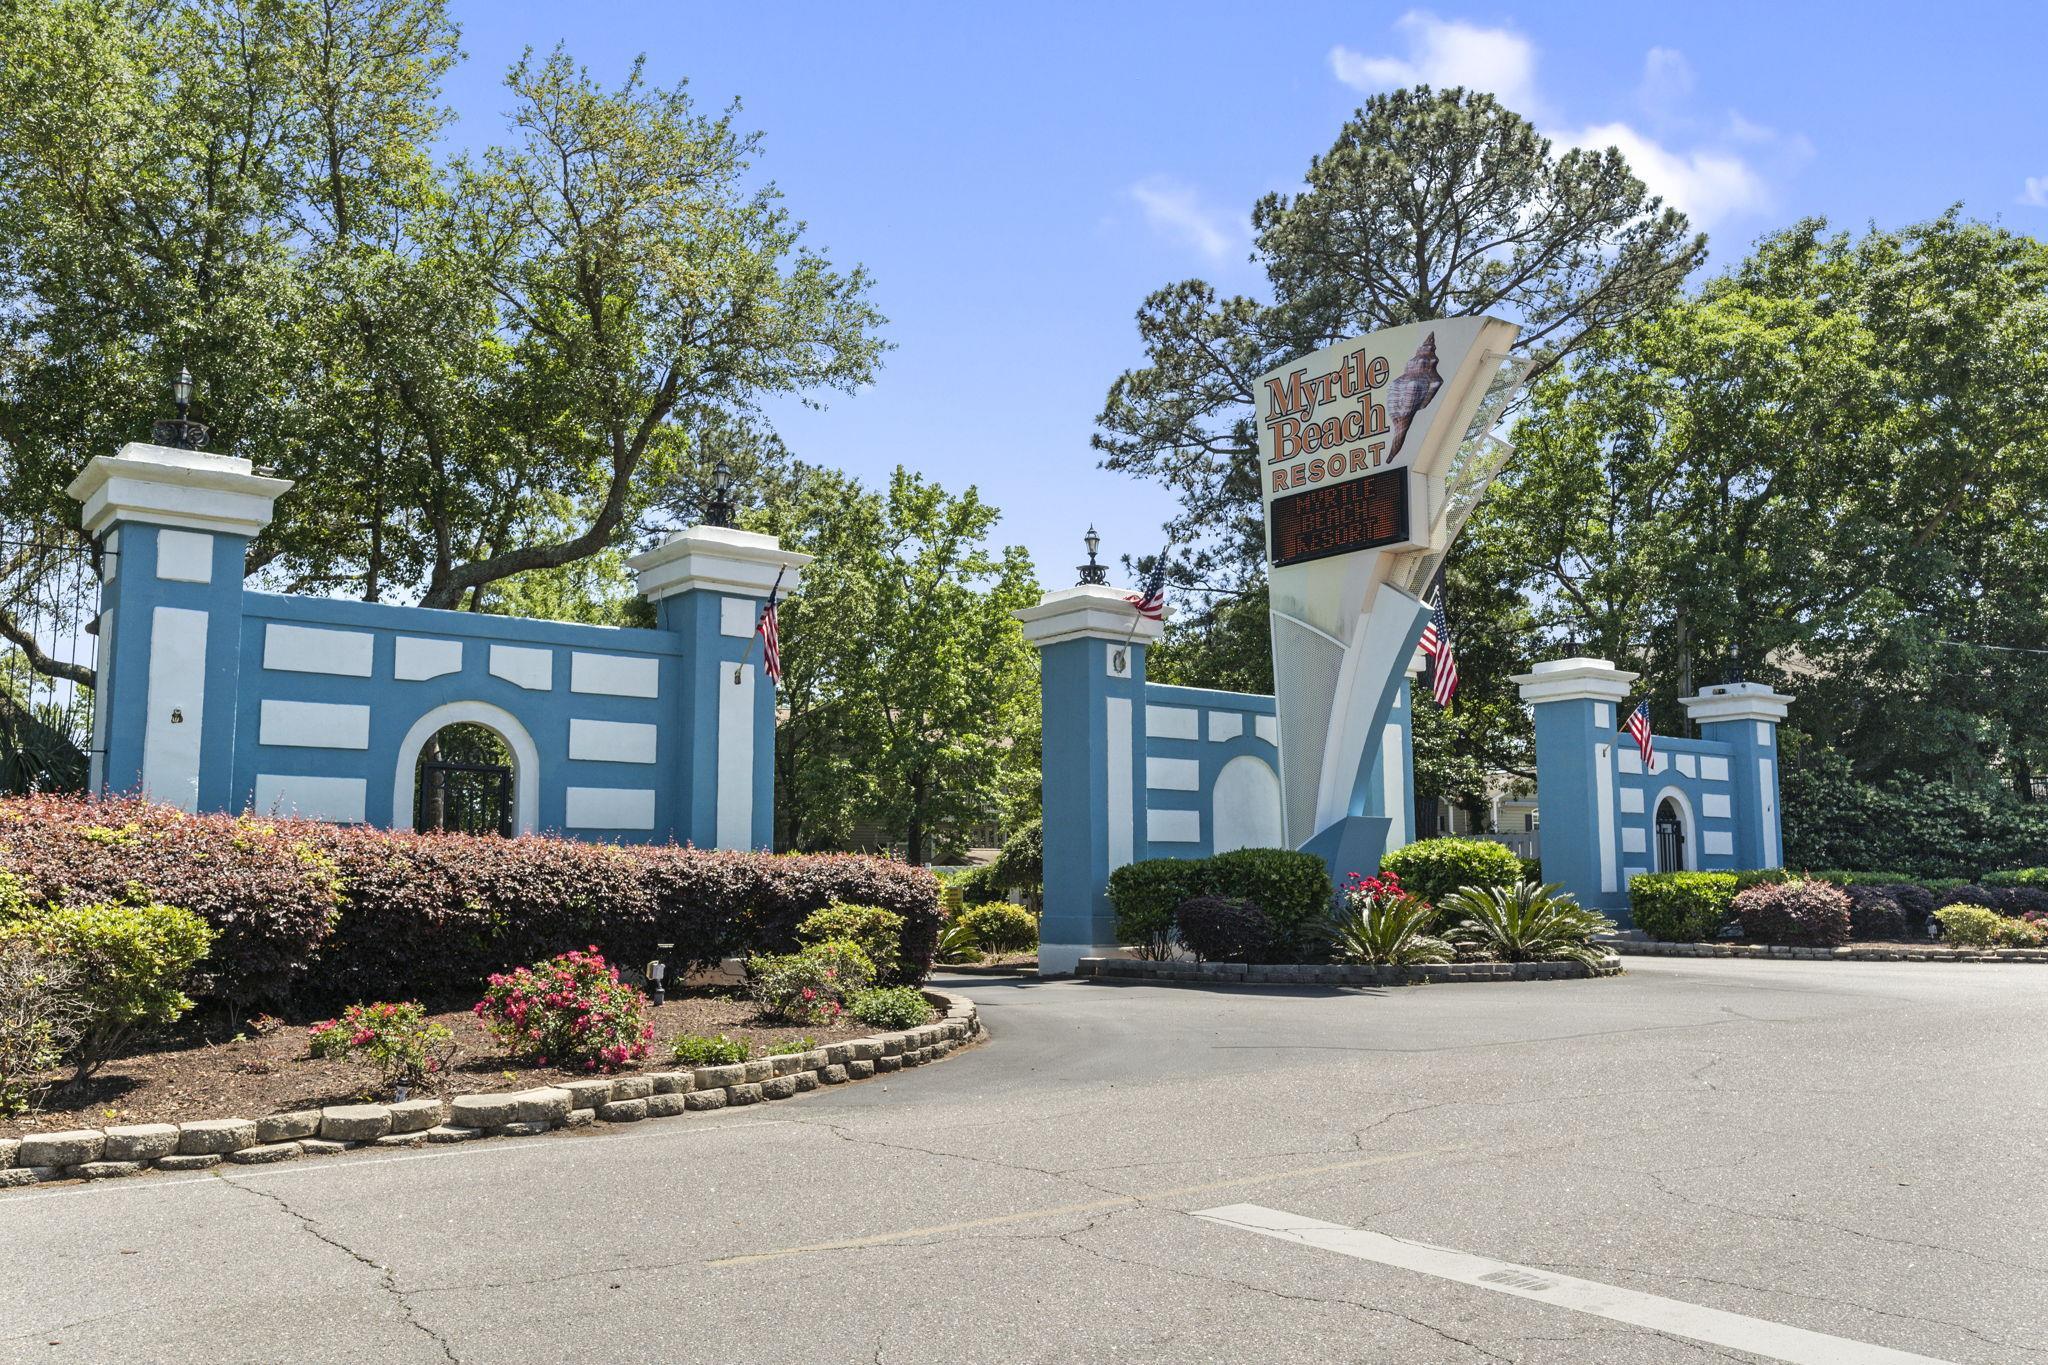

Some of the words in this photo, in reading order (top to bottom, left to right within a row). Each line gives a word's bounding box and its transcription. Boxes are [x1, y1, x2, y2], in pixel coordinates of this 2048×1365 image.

[1264, 348, 1389, 423] Myrtle
[1267, 393, 1390, 465] Beach
[1273, 442, 1385, 493] RESORT
[1297, 478, 1375, 514] MYRTLE
[1302, 499, 1368, 533] BEACH
[1296, 518, 1375, 554] RESORT
